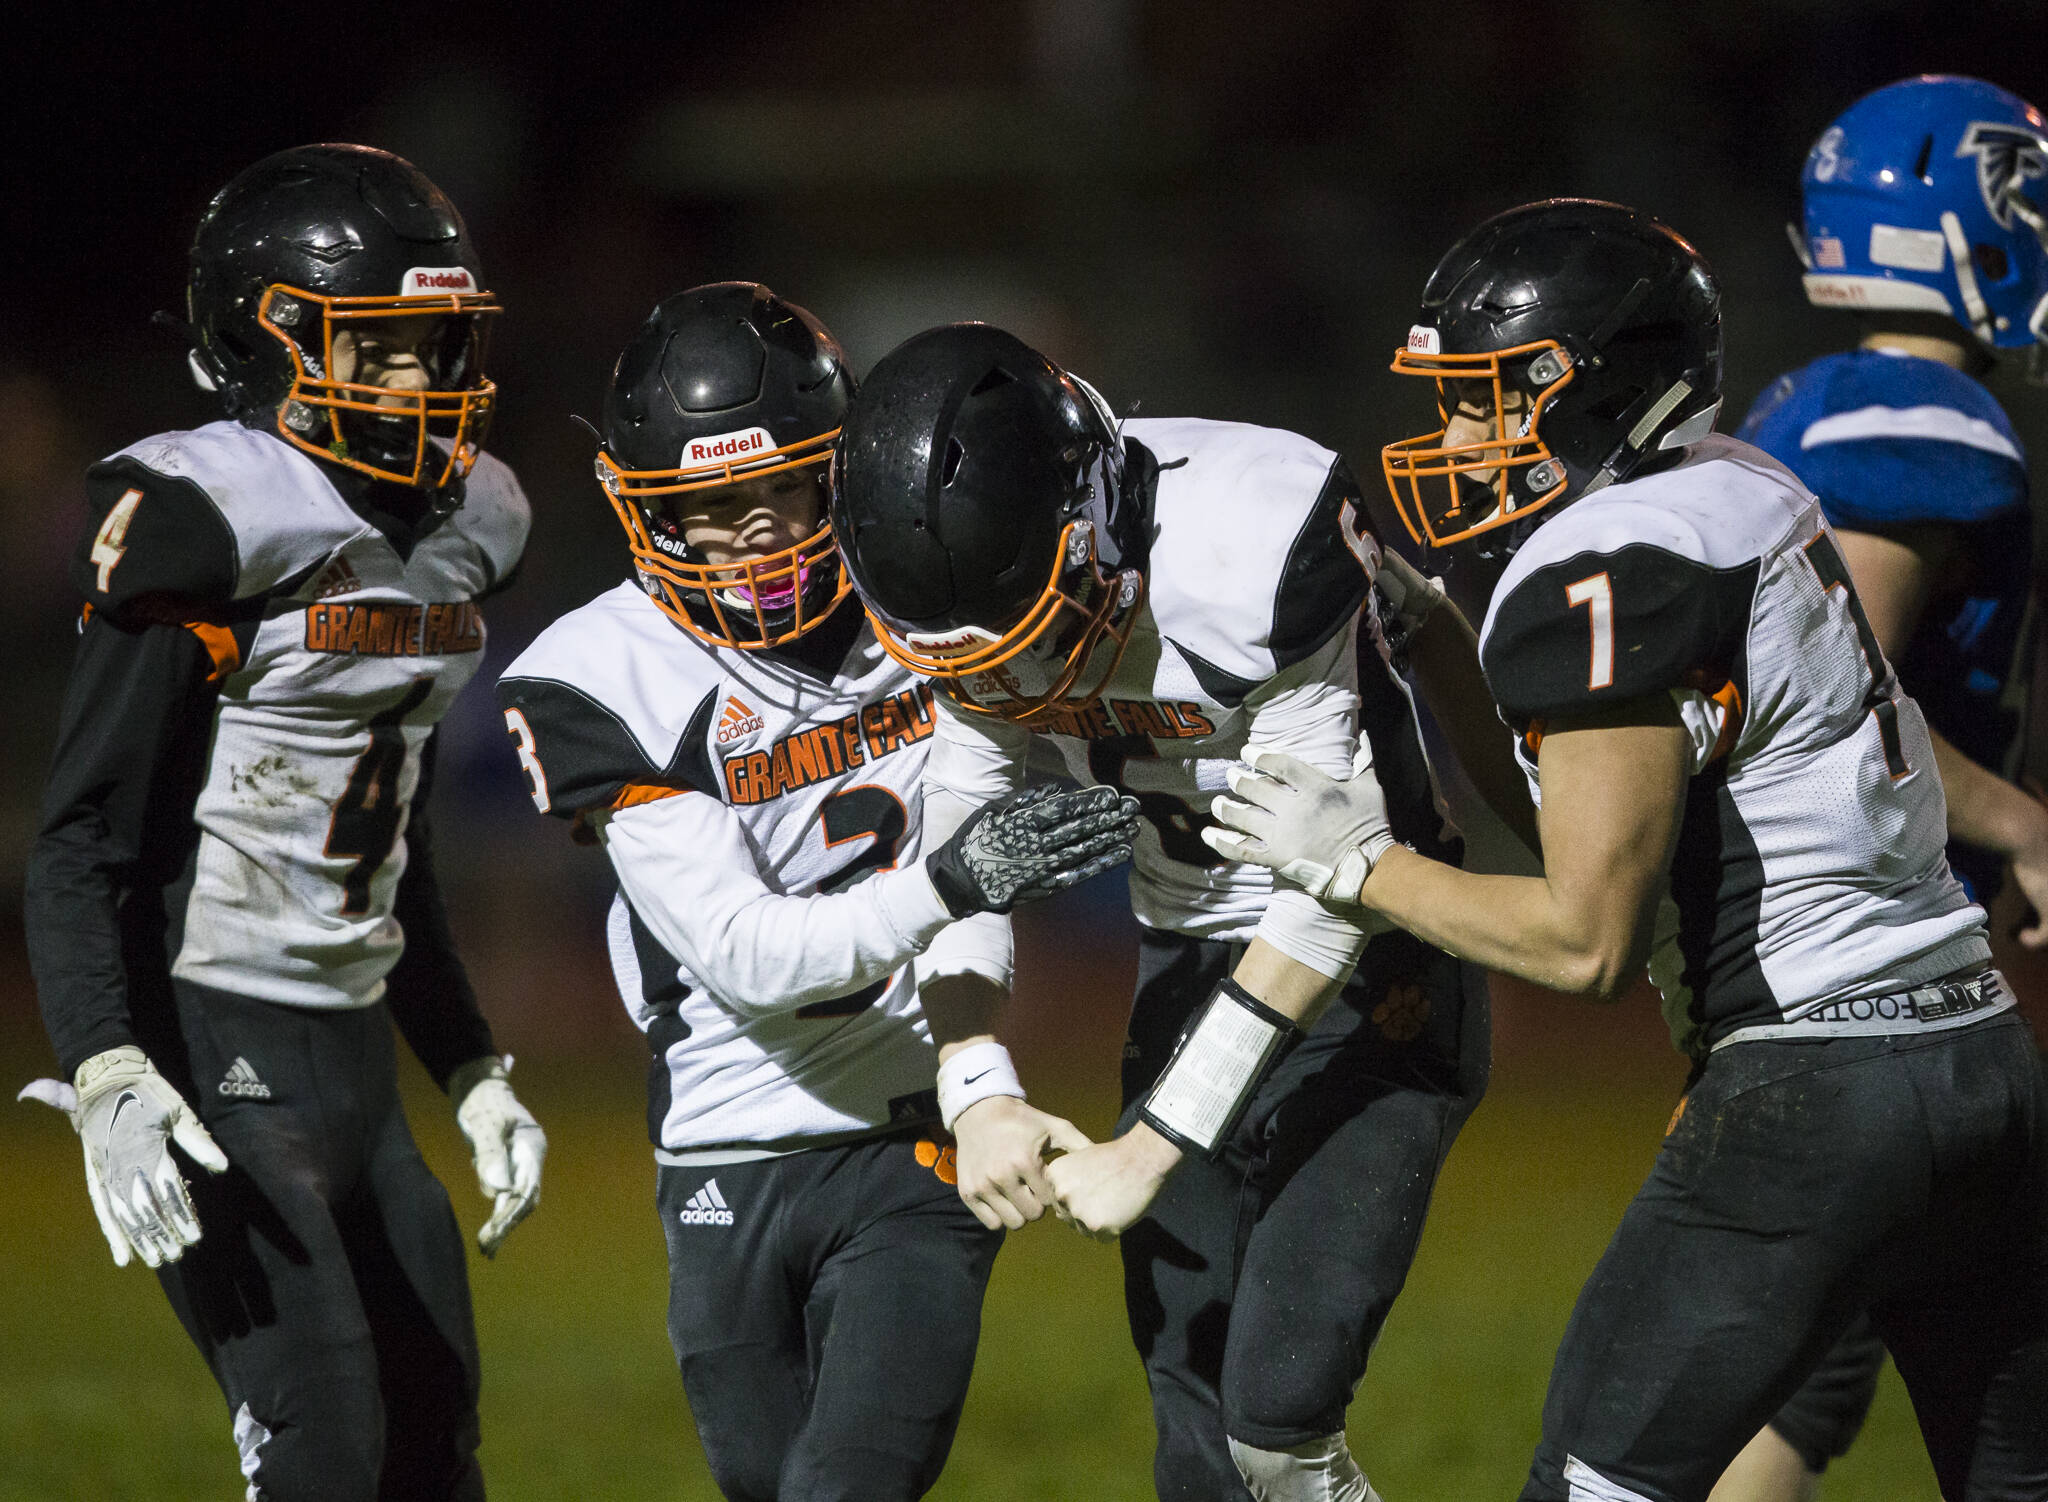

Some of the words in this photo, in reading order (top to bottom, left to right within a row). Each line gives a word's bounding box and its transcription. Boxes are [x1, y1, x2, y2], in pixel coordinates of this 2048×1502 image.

[415, 272, 470, 288] Riddell
[1408, 332, 1430, 348] ddell
[691, 432, 763, 460] Riddell
[90, 488, 144, 593] 4
[717, 715, 765, 743] adidas
[1110, 698, 1217, 739] FALLS
[503, 706, 552, 814] 3
[723, 713, 866, 806] GRANITE
[322, 674, 435, 915] 4
[219, 1080, 271, 1099] adidas
[680, 1206, 734, 1225] adidas
